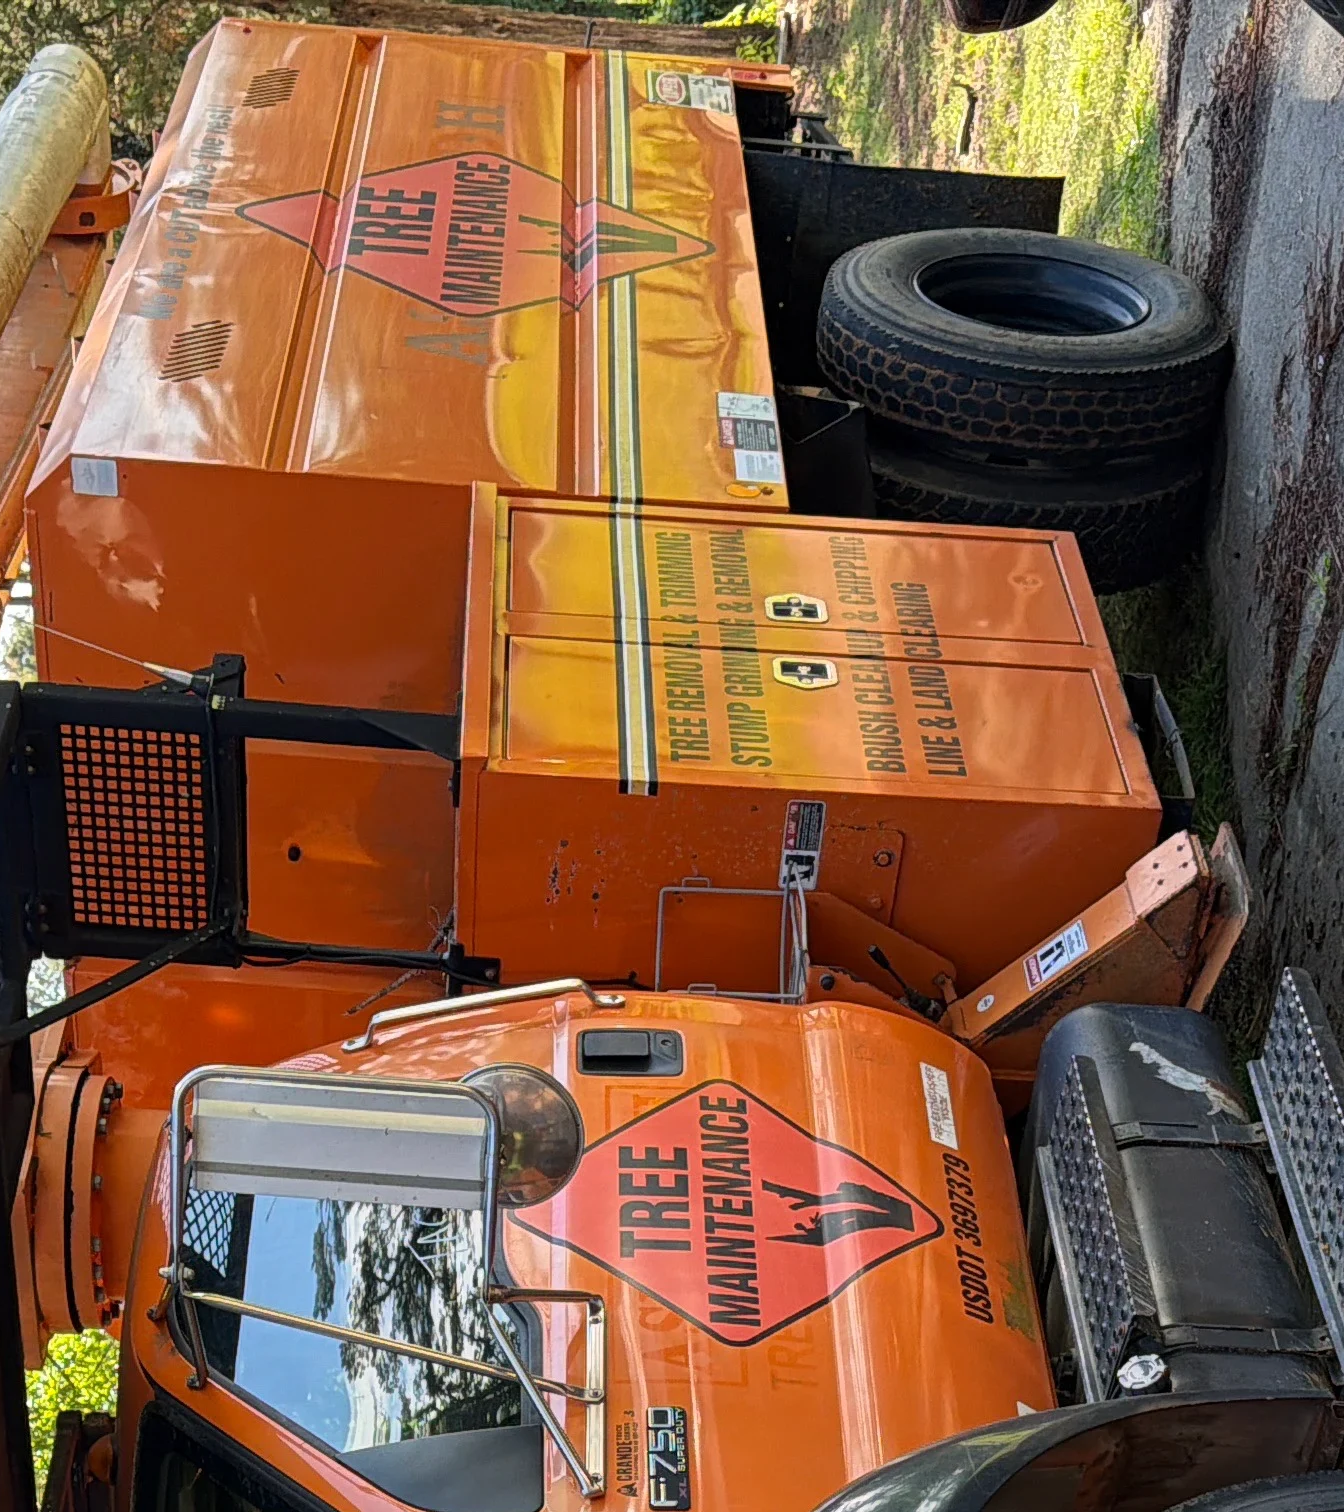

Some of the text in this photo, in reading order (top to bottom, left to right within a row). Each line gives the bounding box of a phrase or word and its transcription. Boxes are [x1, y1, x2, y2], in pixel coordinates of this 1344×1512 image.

[137, 104, 234, 320] We are a CUT above the rest!
[346, 186, 437, 257] TREE
[439, 160, 512, 307] MAINTENANCE
[654, 531, 711, 763] TREE REMOVAL & TRIMMING
[708, 528, 773, 768] STUMP GRINDING & REMOVAL
[827, 535, 908, 774] BRUSH CLEANUP & CHIPPING
[889, 582, 968, 777] LINE & LAND CLEARING
[617, 1145, 692, 1260] TREE
[698, 1094, 762, 1328] MAINTENANCE
[942, 1152, 995, 1325] USDOT 3697379
[674, 1406, 688, 1499] XL SUPER DUTY
